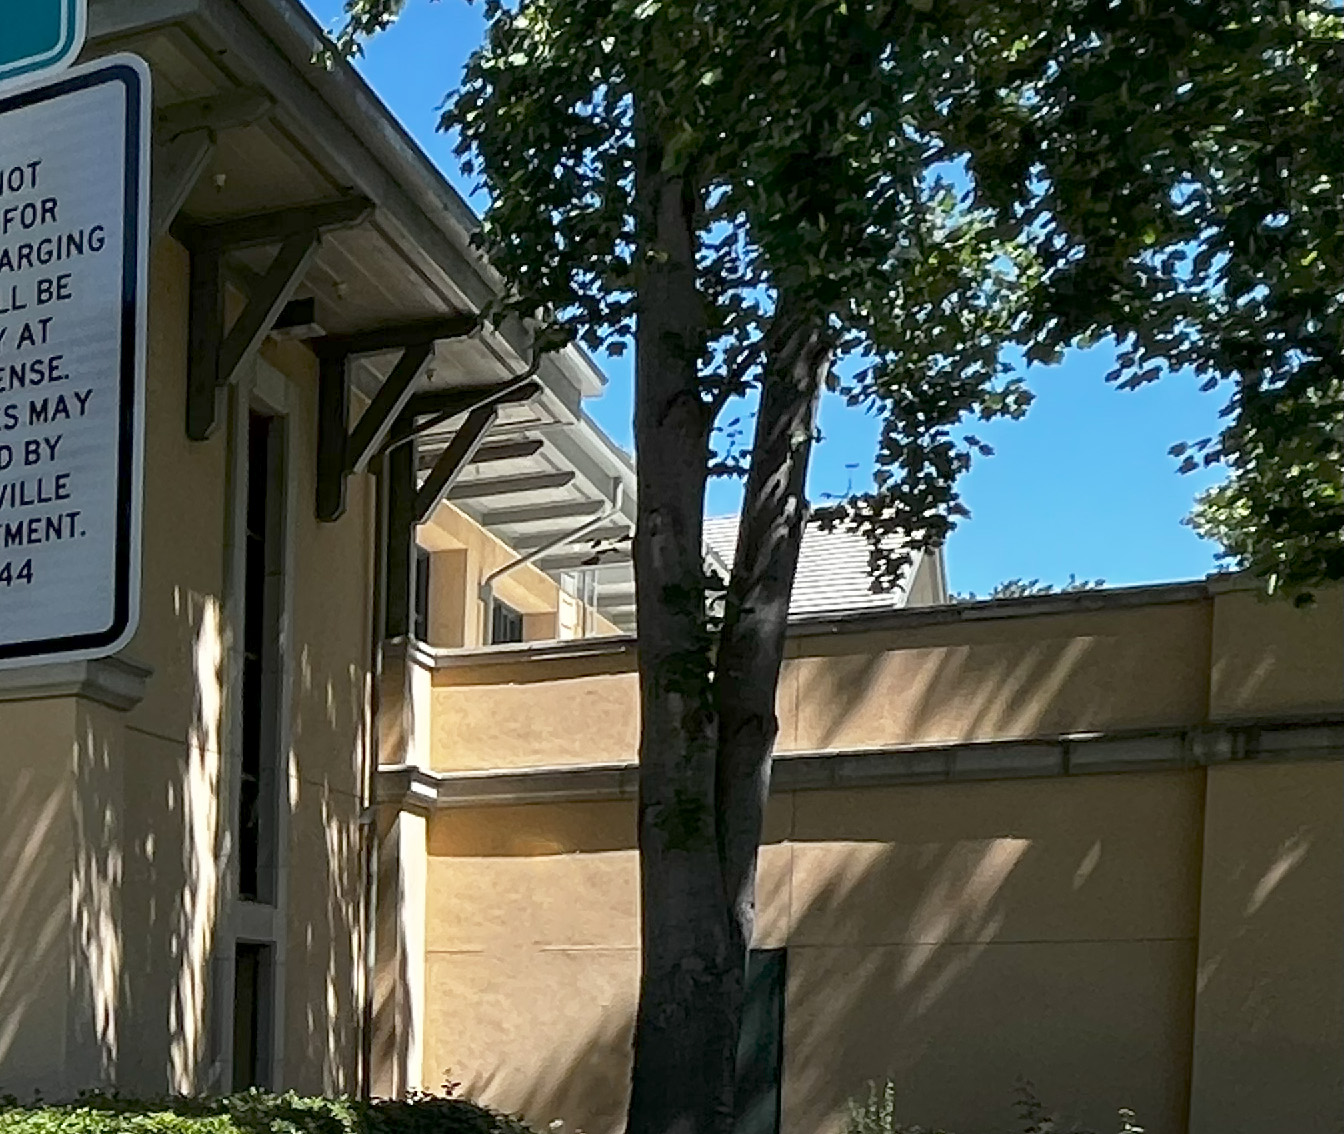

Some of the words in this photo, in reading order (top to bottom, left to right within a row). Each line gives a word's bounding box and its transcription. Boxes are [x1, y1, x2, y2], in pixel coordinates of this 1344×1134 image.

[2, 197, 58, 235] FOR
[36, 273, 73, 306] BE
[16, 316, 54, 350] AT
[28, 388, 94, 426] MAY
[23, 434, 63, 466] BY
